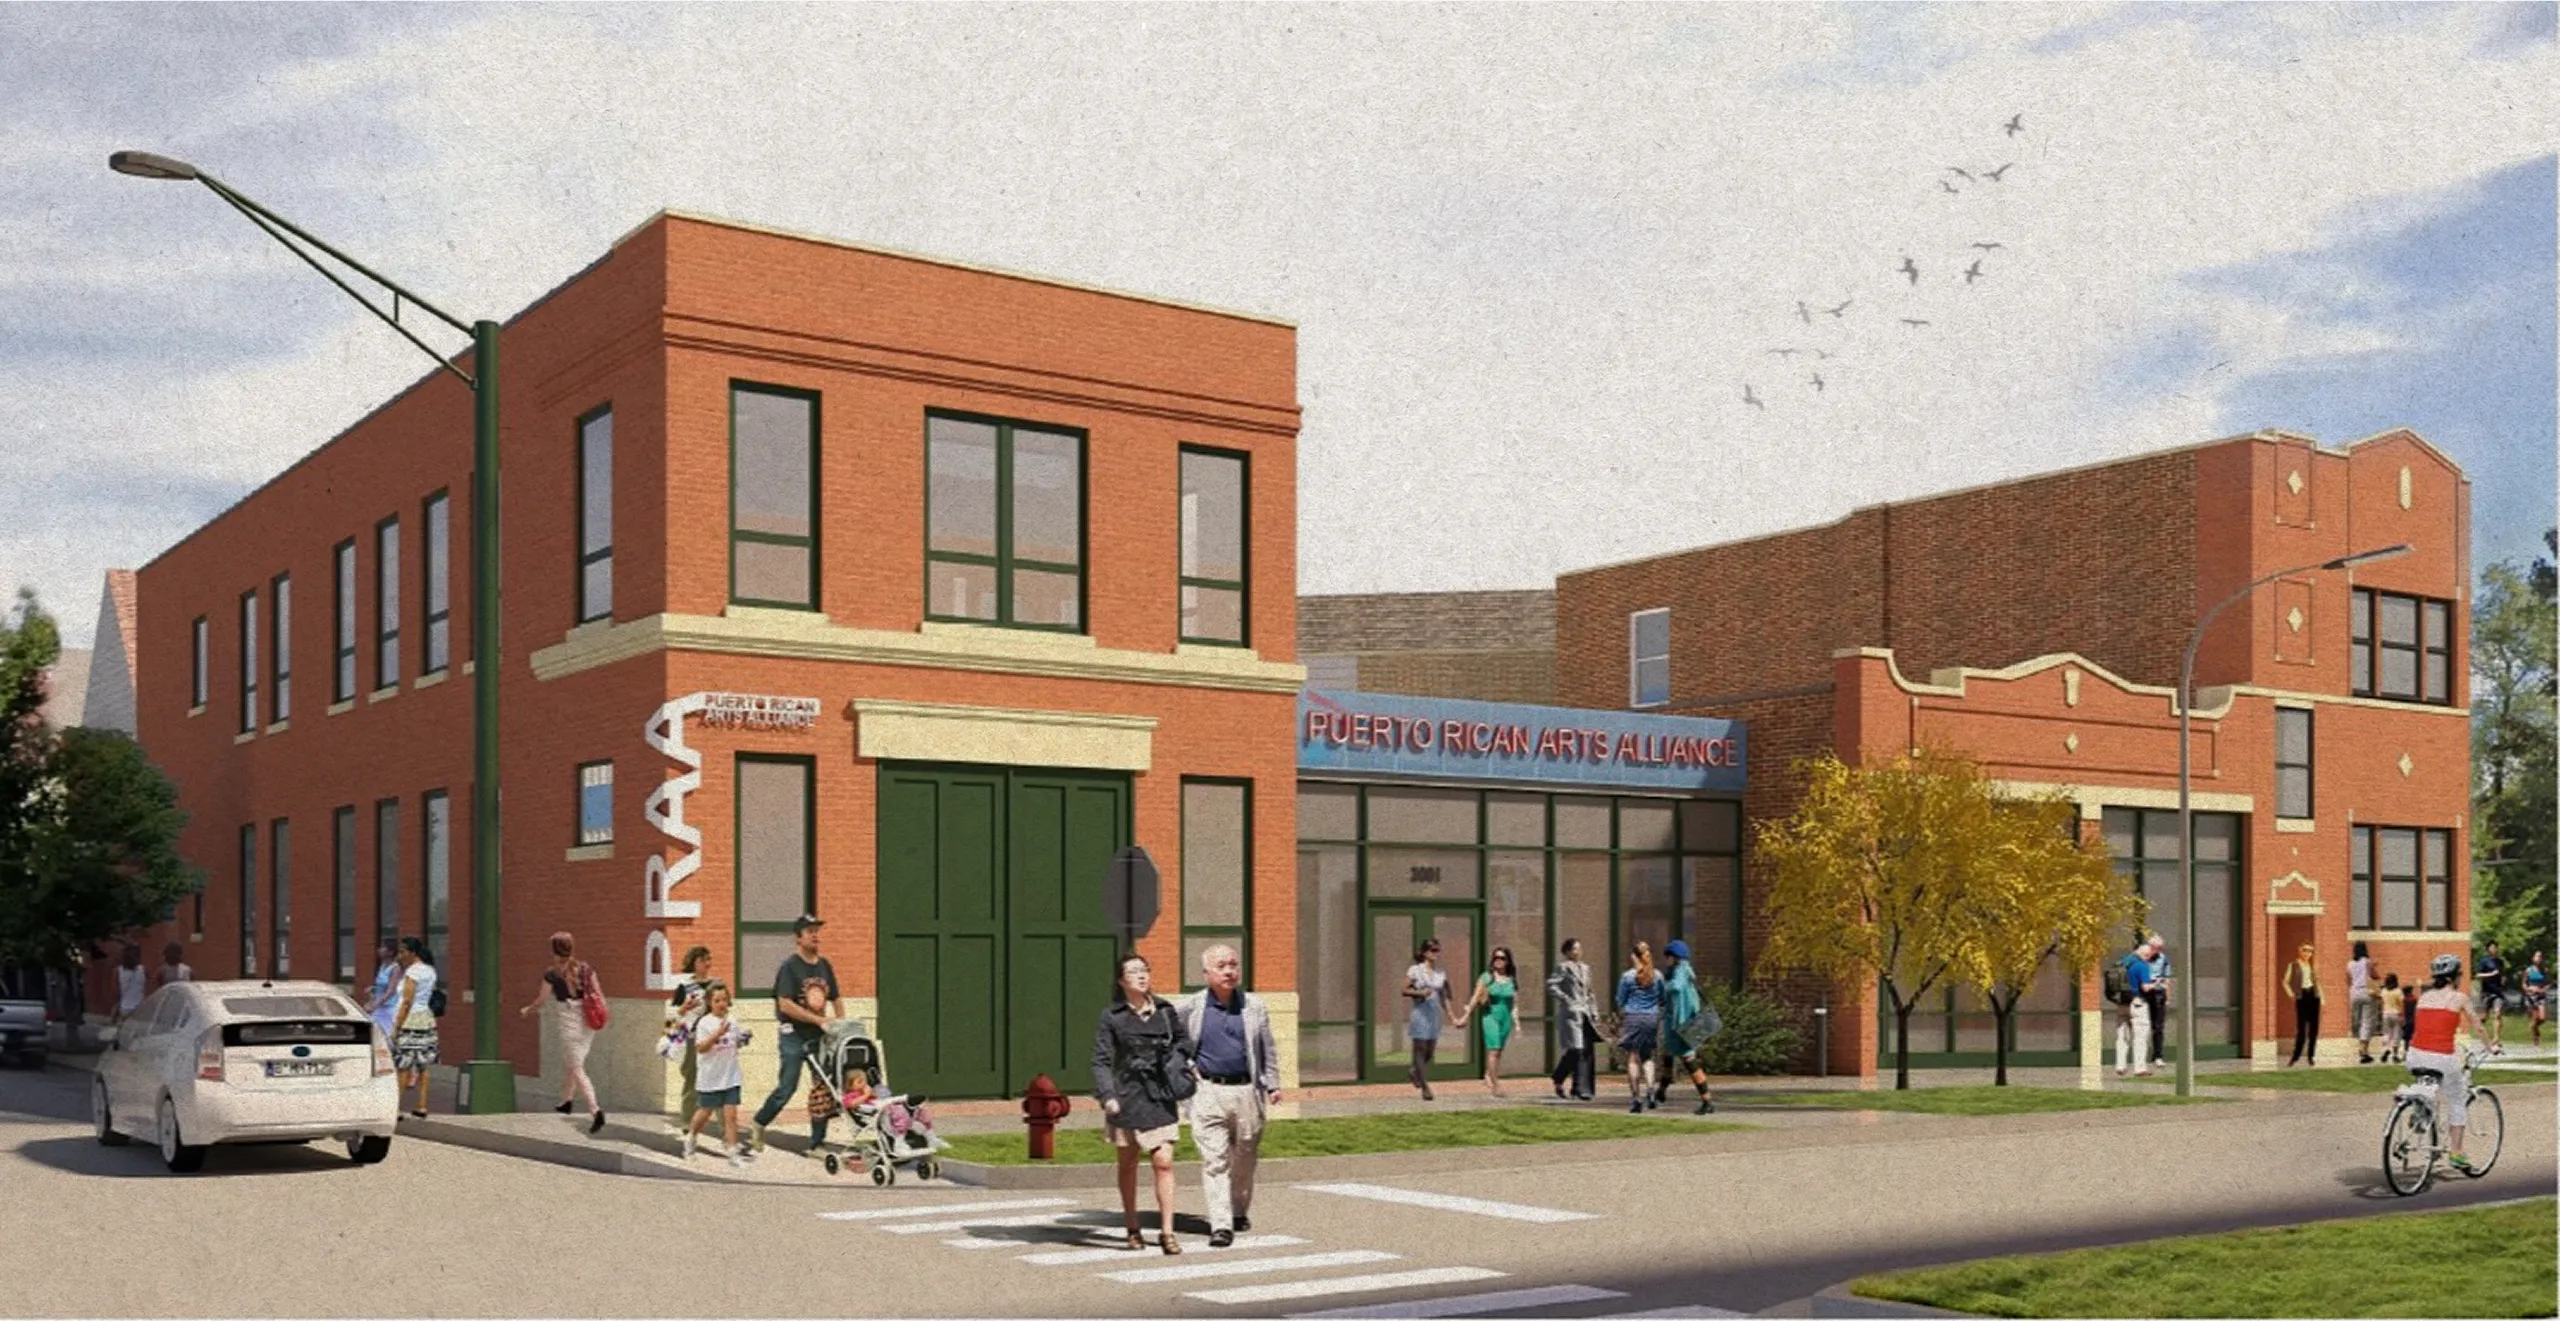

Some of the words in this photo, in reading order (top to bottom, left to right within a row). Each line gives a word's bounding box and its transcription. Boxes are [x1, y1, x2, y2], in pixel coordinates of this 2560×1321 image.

[704, 694, 766, 710] PUERTO
[769, 697, 816, 713] RICAN
[1305, 710, 1434, 752] PUERTO
[1440, 719, 1530, 757] RICAN
[1537, 726, 1609, 761] ARTS
[1614, 731, 1740, 767] ALLIANCE
[645, 691, 702, 990] PRAA
